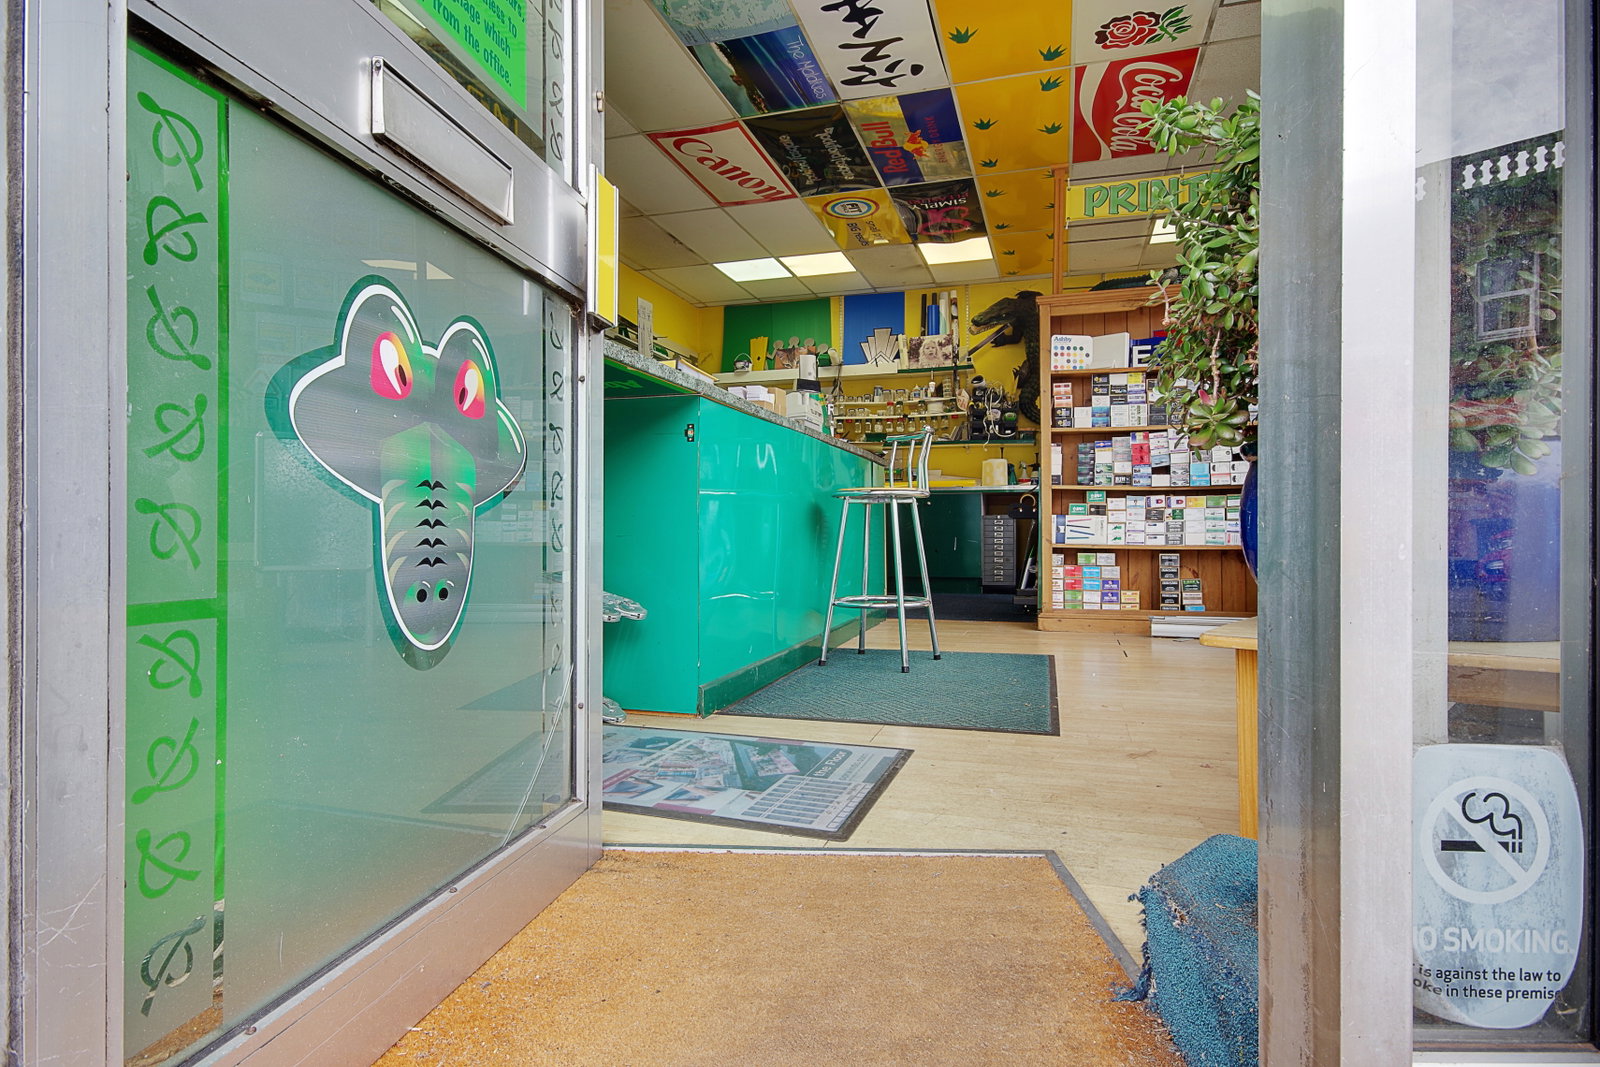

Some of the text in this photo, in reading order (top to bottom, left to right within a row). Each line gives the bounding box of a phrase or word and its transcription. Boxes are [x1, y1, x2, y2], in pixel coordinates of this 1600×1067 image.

[484, 18, 511, 58] which
[508, 16, 517, 38] to
[463, 23, 480, 53] the
[483, 47, 512, 87] office.
[786, 35, 827, 99] The Maldives
[860, 121, 910, 174] Red Bull
[672, 137, 791, 200] Canon
[911, 197, 968, 210] SIMPLY
[1413, 926, 1438, 951] O
[1413, 978, 1443, 995] oke
[1446, 984, 1459, 997] in
[1462, 985, 1502, 998] these
[1418, 964, 1561, 983] is against the law to
